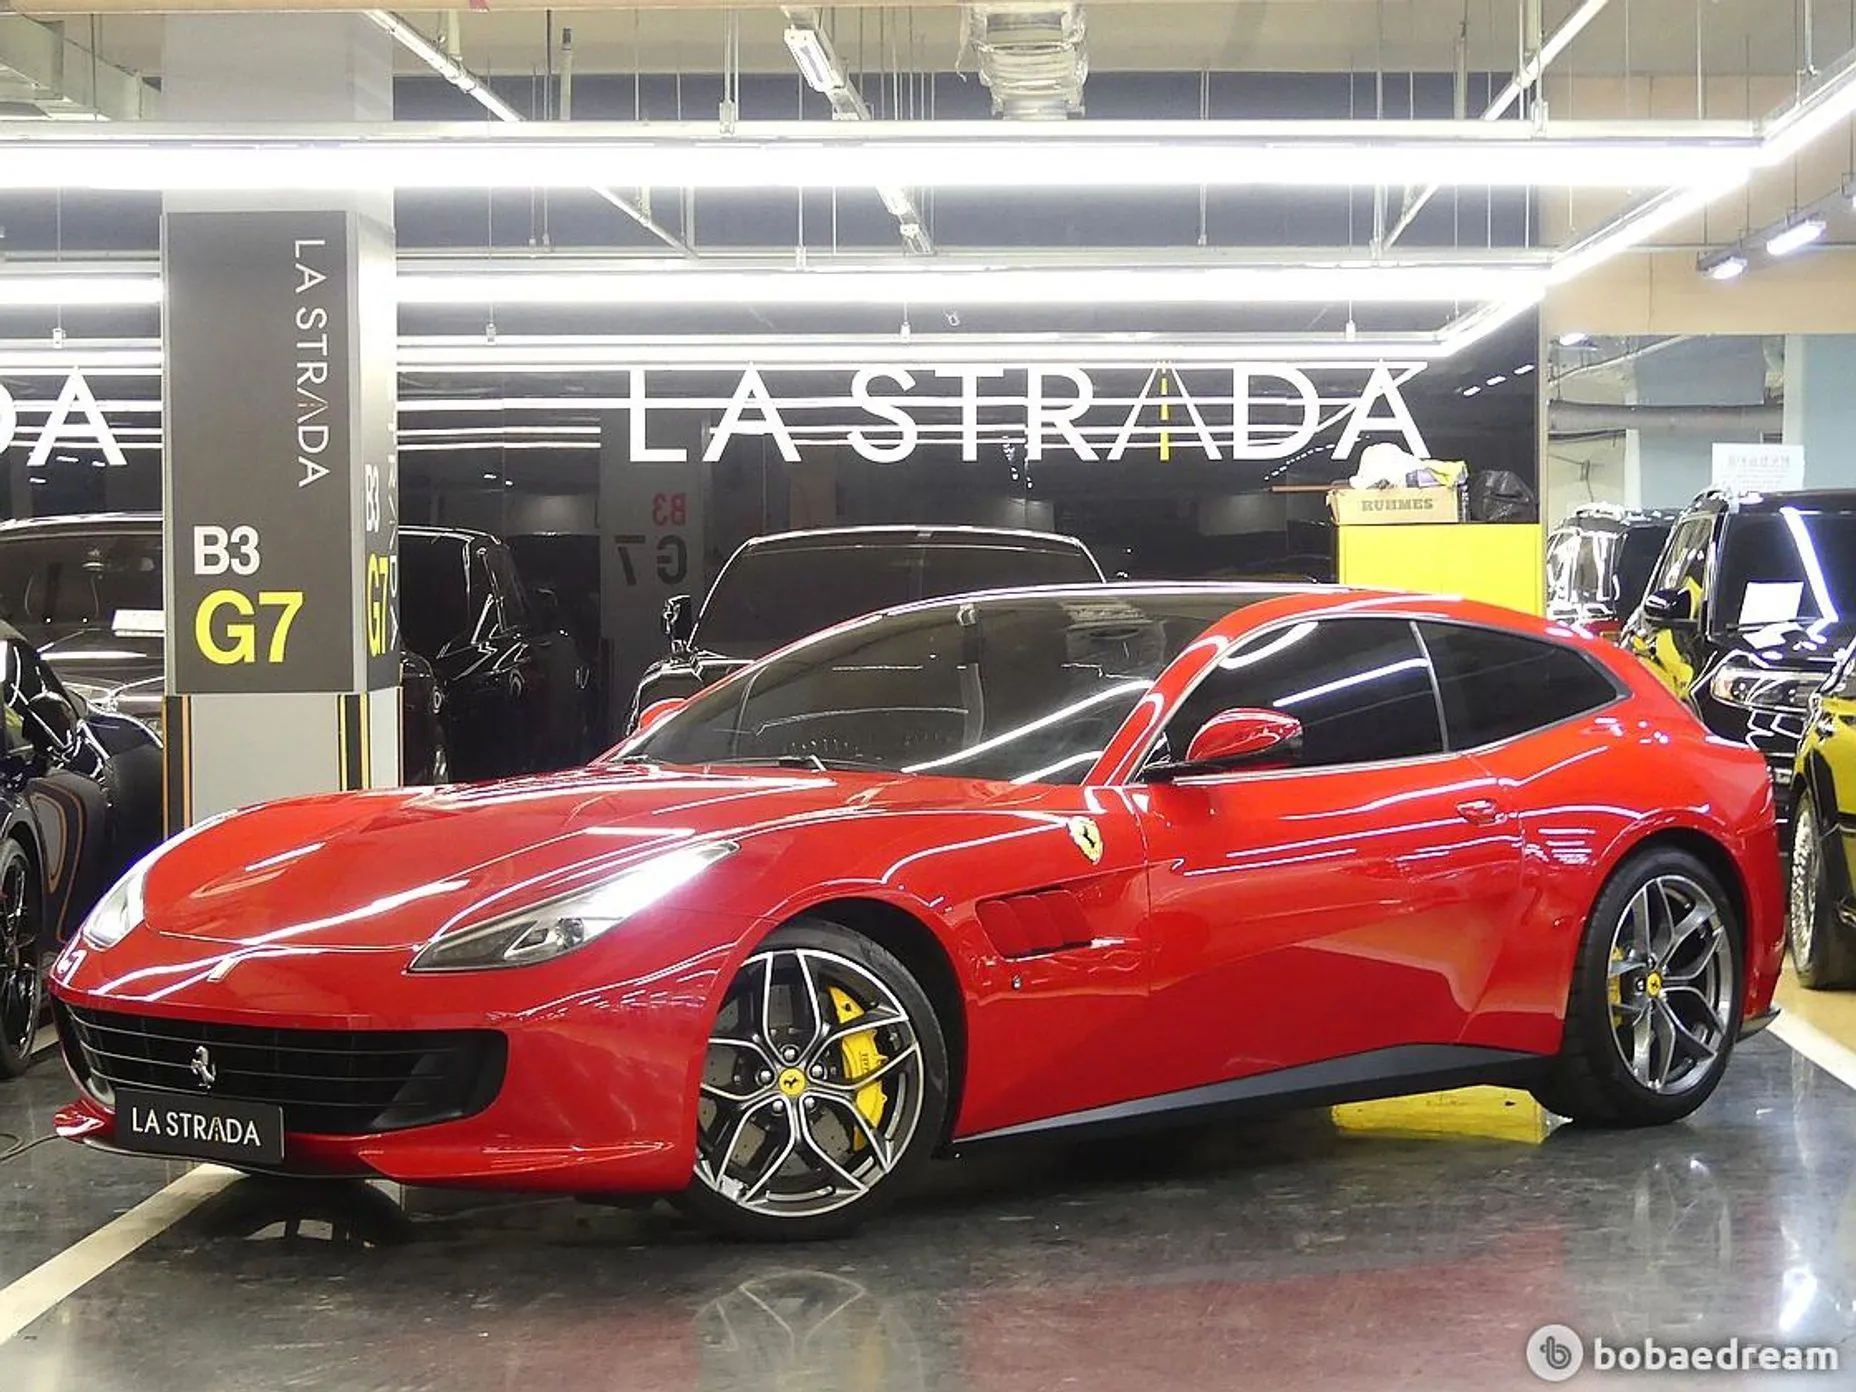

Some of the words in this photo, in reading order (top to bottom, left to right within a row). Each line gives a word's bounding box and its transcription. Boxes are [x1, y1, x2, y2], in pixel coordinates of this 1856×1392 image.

[295, 240, 327, 293] LA
[0, 365, 128, 466] A
[295, 307, 331, 487] STRADA
[630, 361, 801, 462] LA
[847, 359, 1431, 464] STRADA
[365, 463, 380, 533] B3
[193, 525, 260, 575] B3
[195, 589, 304, 664] G7
[367, 553, 389, 657] G7
[131, 1106, 161, 1135] LA
[166, 1111, 262, 1147] STRADA
